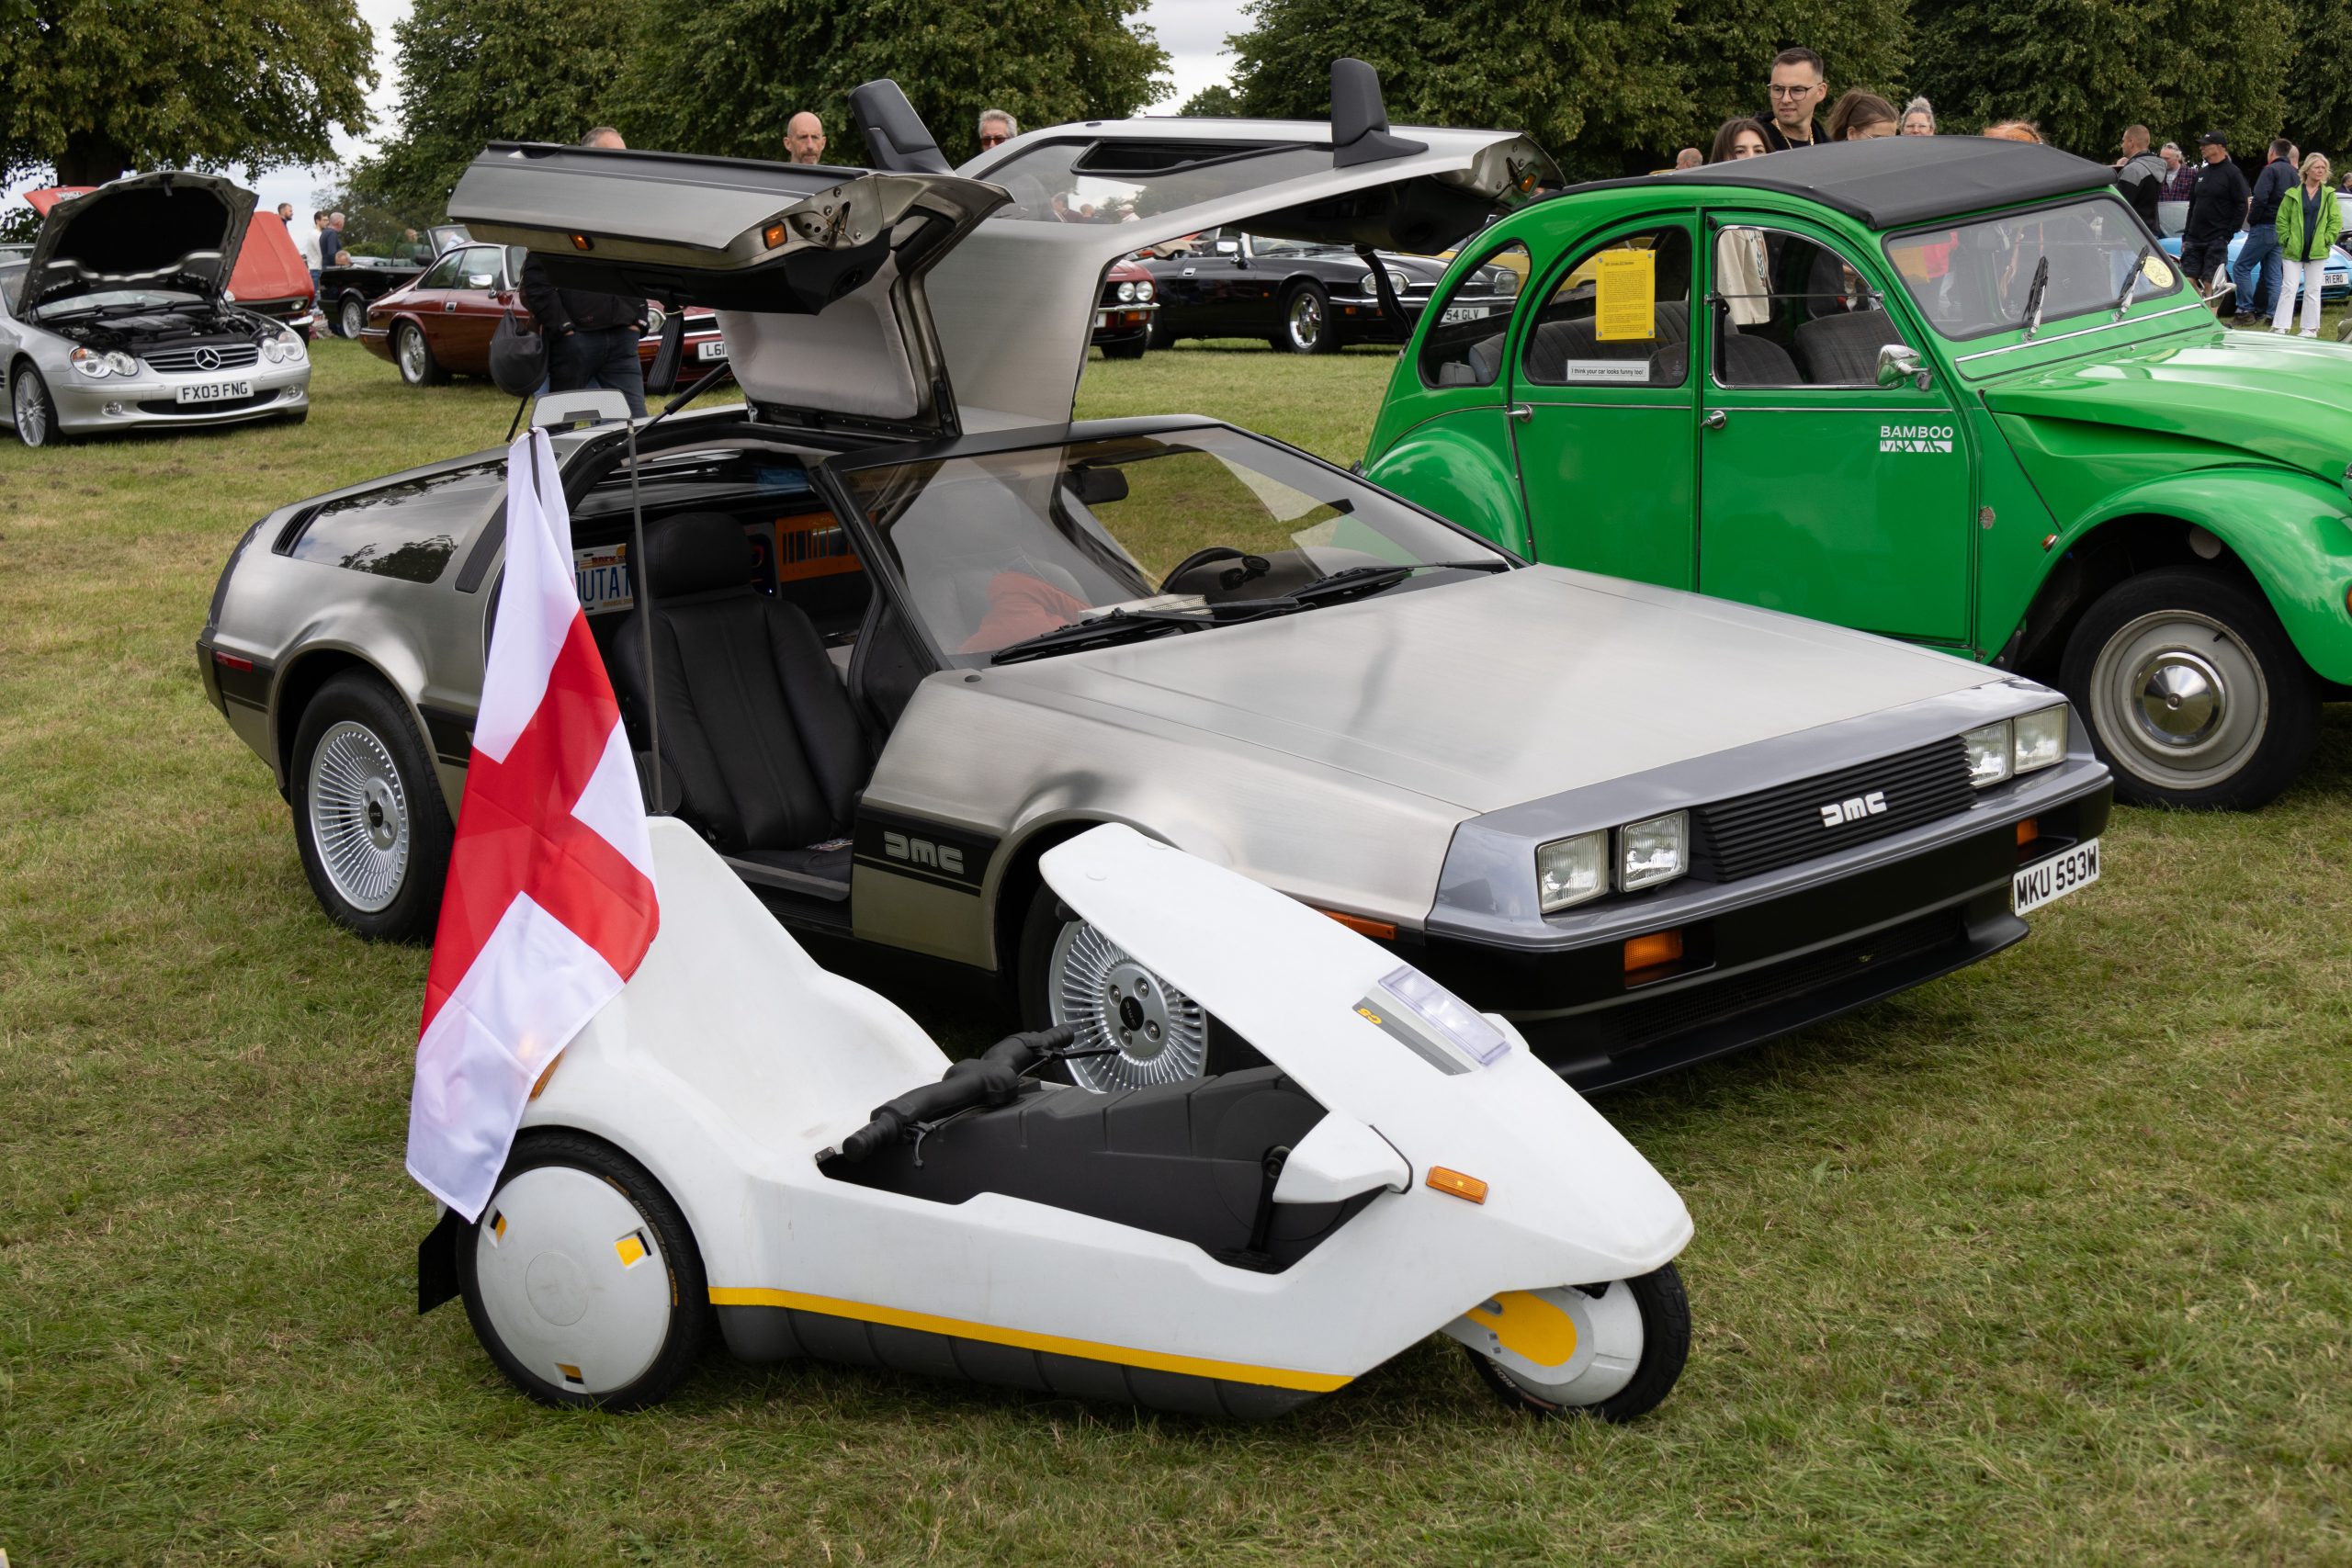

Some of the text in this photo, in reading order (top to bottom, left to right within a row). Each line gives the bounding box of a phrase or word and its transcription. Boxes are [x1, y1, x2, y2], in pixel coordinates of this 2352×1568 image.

[1462, 309, 1479, 320] GLV
[182, 381, 248, 400] FX03 FNG
[1880, 425, 1953, 439] BAMBOO
[1821, 791, 1887, 828] DMC
[883, 830, 965, 874] DMC
[2017, 844, 2098, 909] MKU 593W
